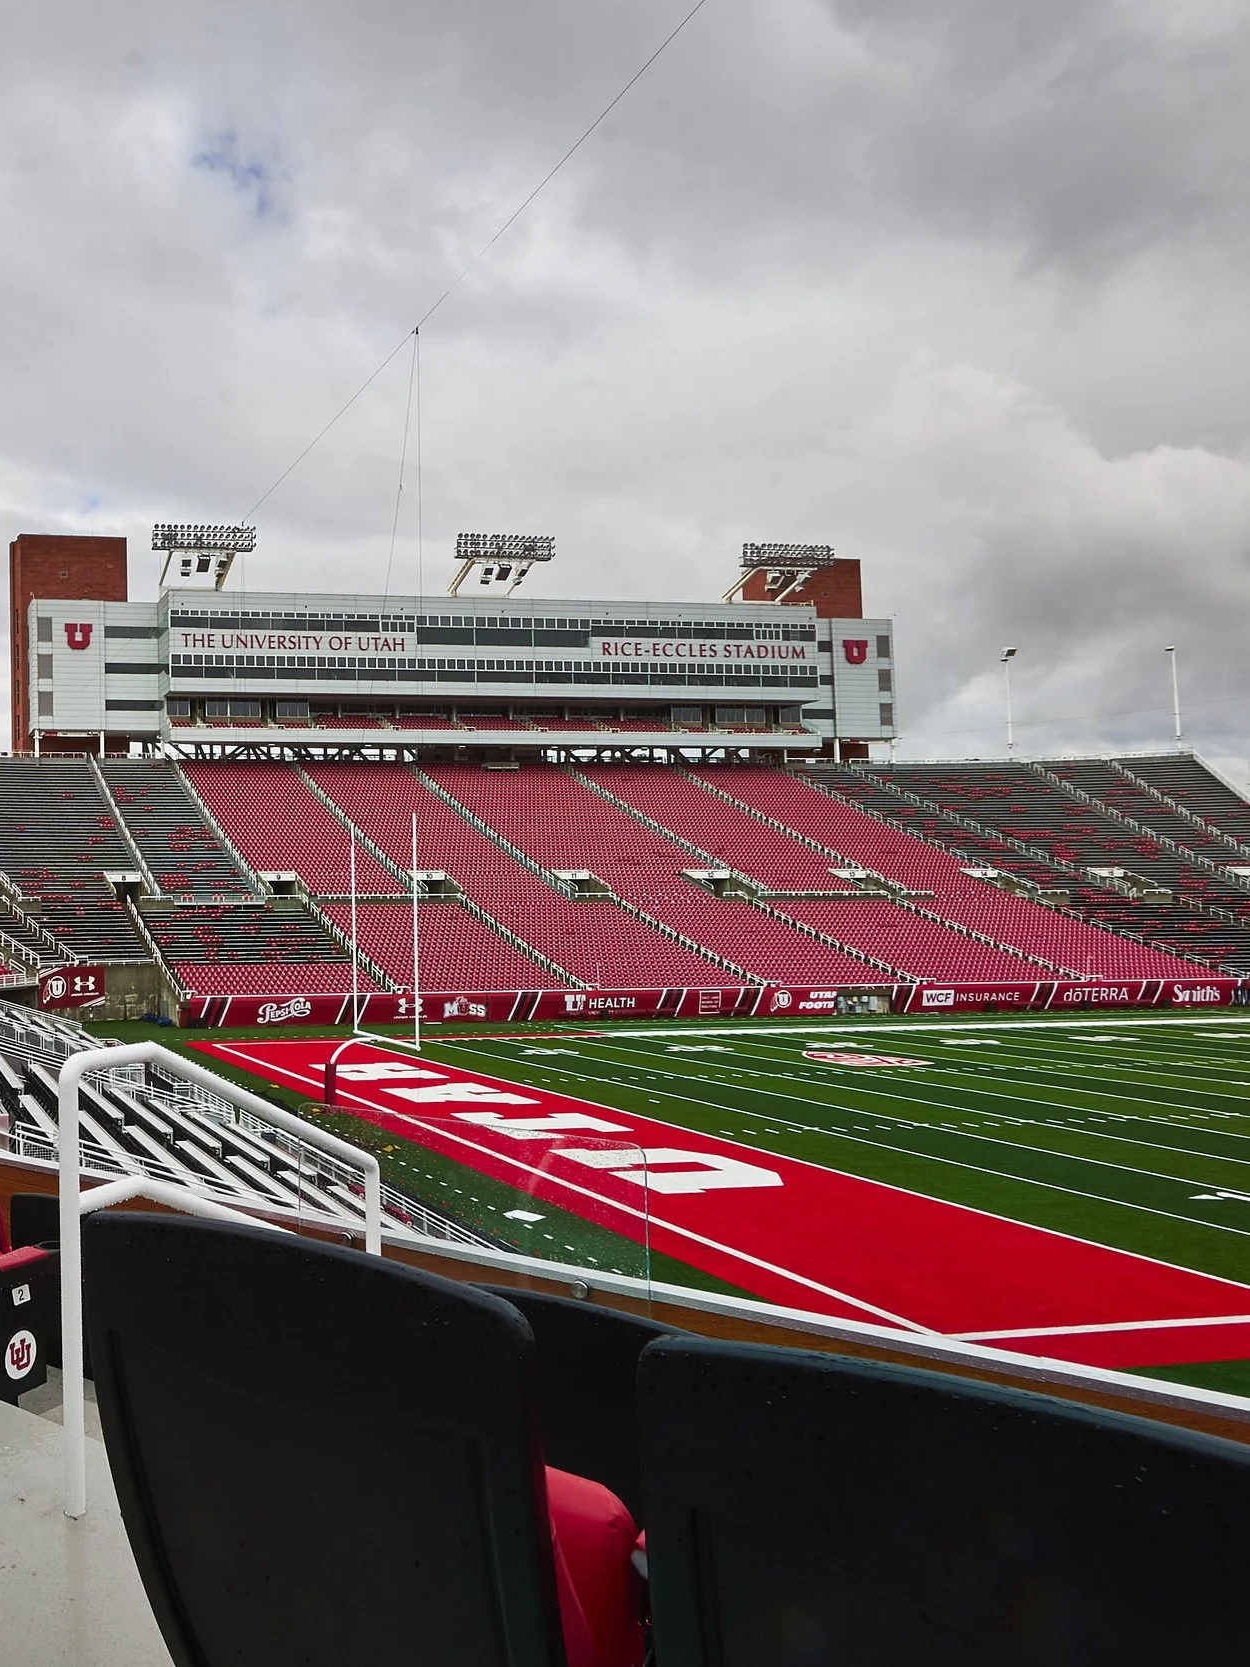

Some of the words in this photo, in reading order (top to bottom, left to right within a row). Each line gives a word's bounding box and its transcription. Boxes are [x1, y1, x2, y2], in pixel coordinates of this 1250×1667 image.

[64, 623, 93, 650] U
[181, 633, 215, 649] THE
[221, 634, 325, 652] UNIVERSITY
[328, 635, 353, 652] OF
[357, 636, 406, 653] UTAH
[601, 641, 717, 658] RICE-ECCLES
[723, 644, 806, 660] STADIUM
[842, 640, 869, 664] U
[51, 980, 64, 996] U
[1172, 984, 1221, 1002] Smith's
[588, 997, 636, 1009] HEALTH
[925, 993, 952, 1003] WCF
[955, 992, 1020, 1002] INSURANCE
[17, 1289, 25, 1302] 2
